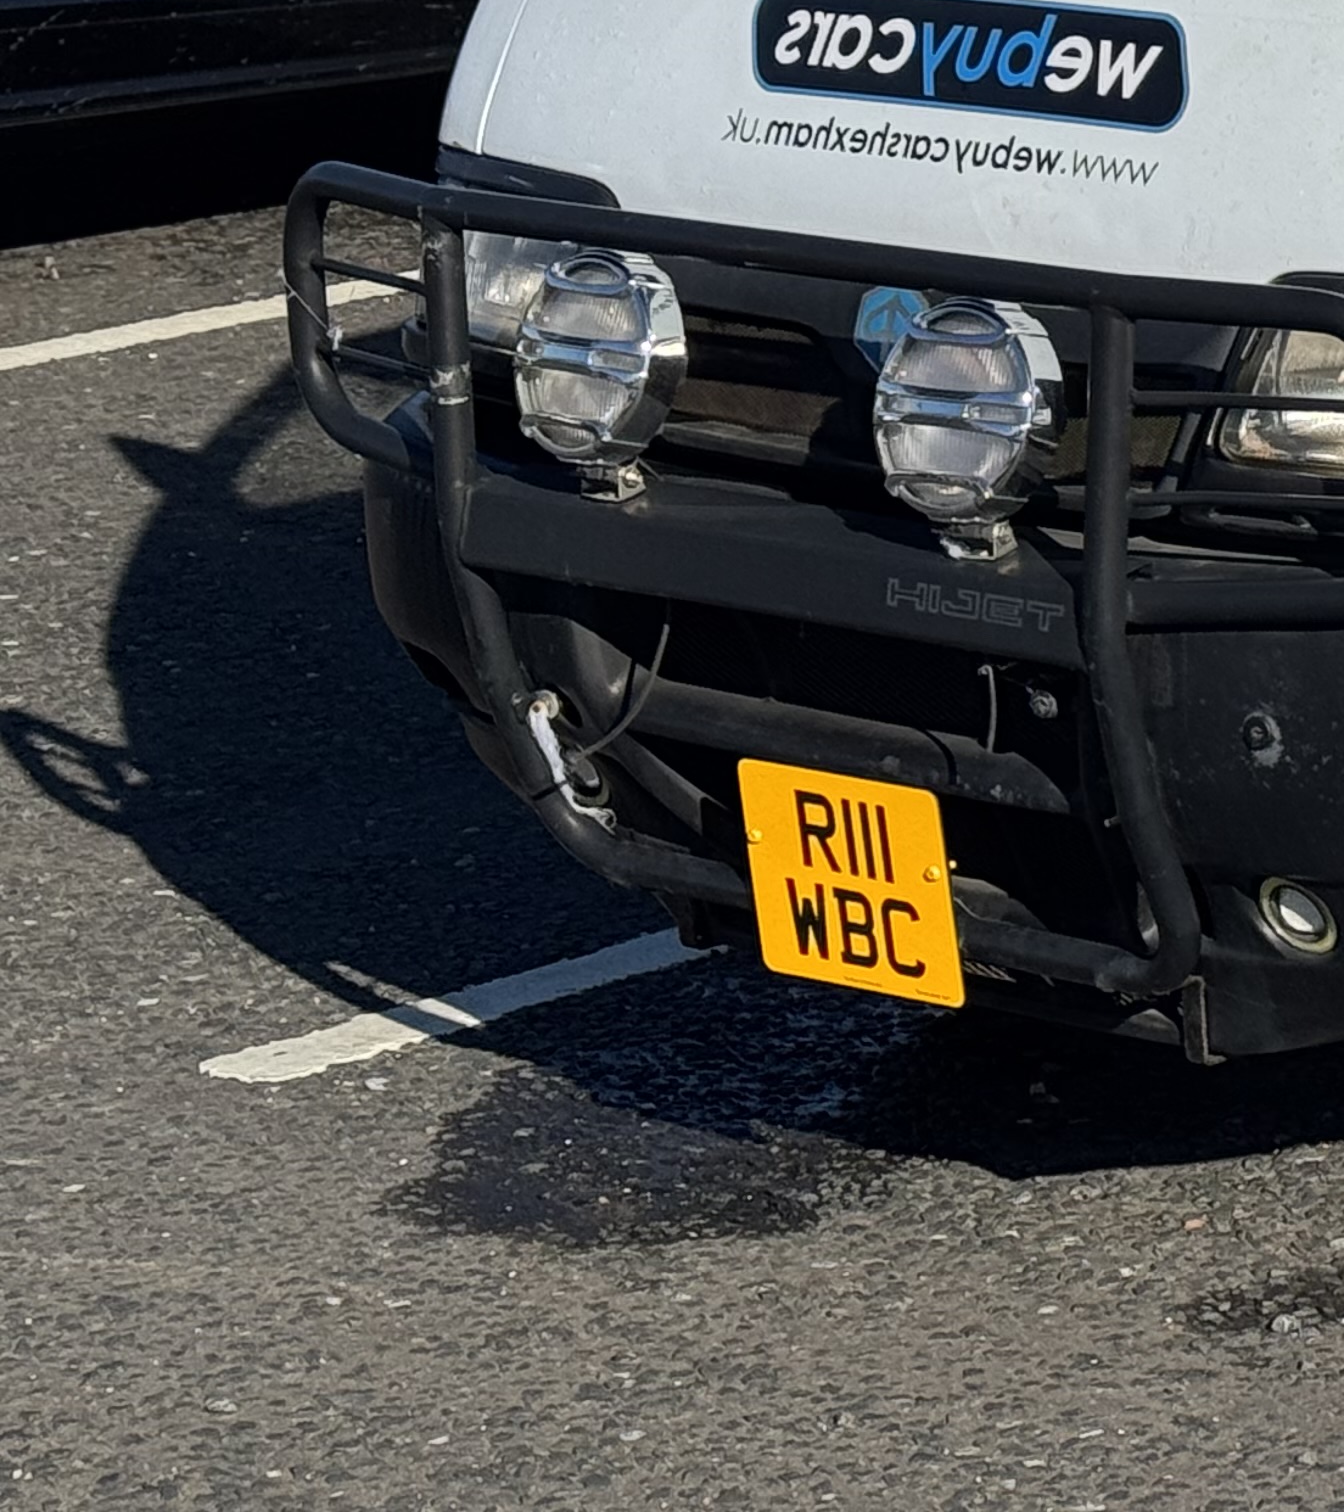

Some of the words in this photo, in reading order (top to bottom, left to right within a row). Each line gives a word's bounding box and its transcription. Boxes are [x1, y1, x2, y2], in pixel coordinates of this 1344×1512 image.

[886, 576, 1065, 633] HIJET
[793, 789, 895, 884] R111
[785, 877, 927, 979] WBC
